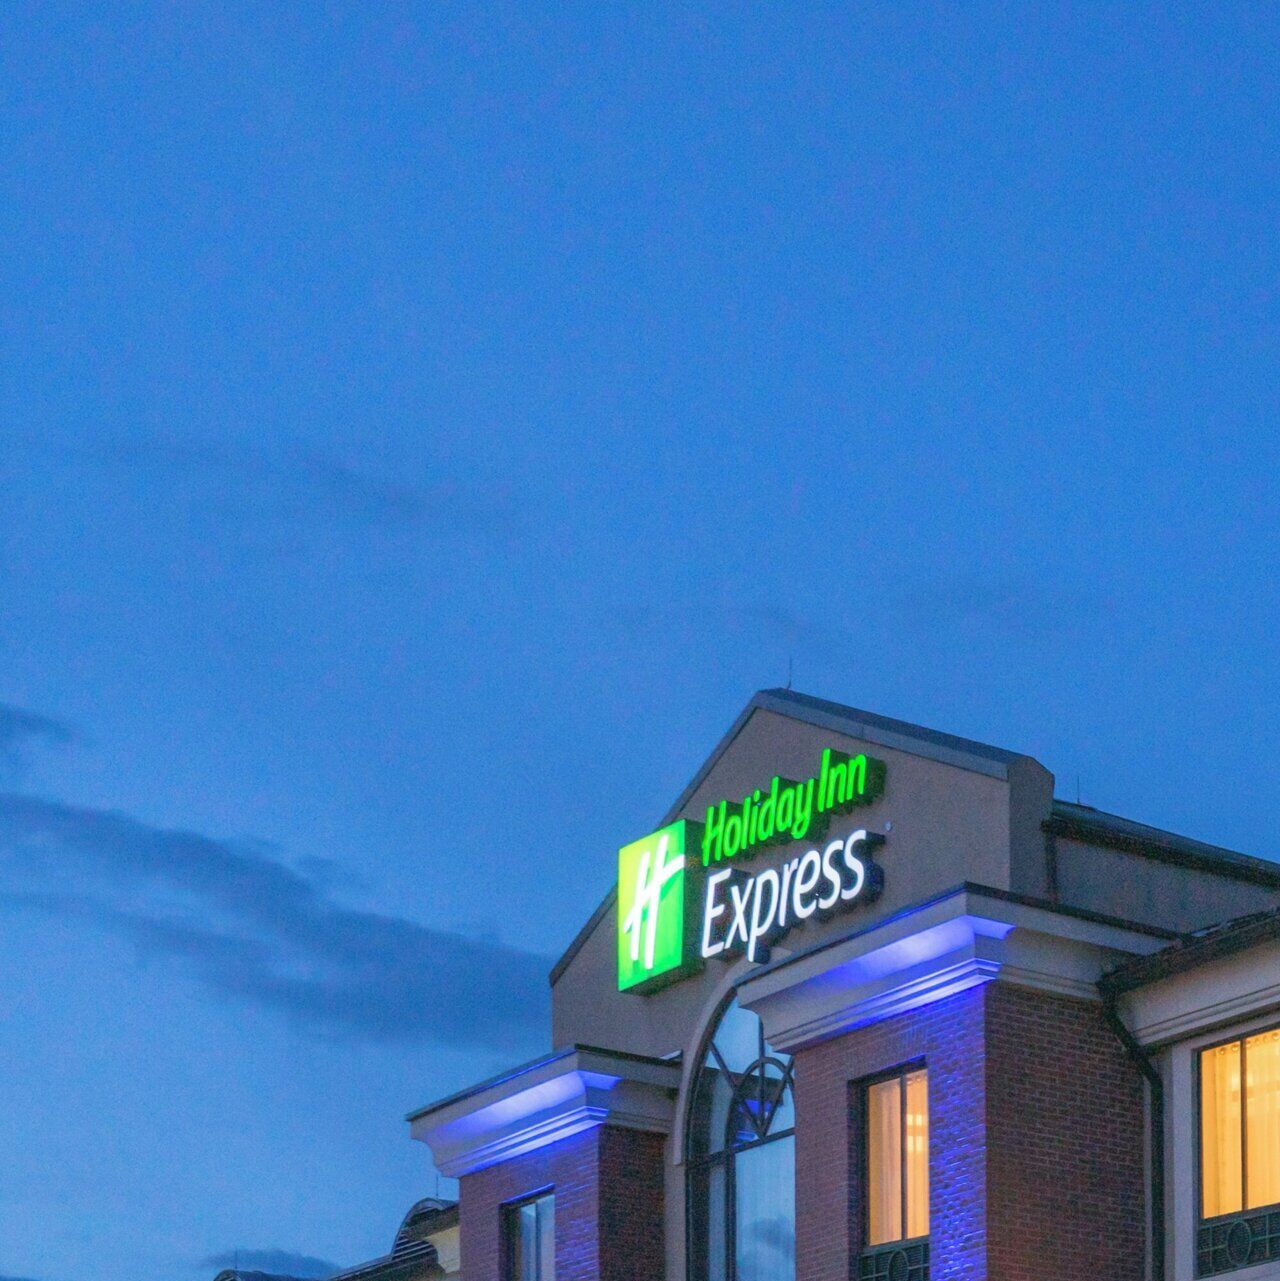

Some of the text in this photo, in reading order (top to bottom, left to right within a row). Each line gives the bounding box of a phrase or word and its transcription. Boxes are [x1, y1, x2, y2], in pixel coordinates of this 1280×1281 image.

[702, 748, 867, 866] Holiday Inn
[702, 829, 867, 962] Express
